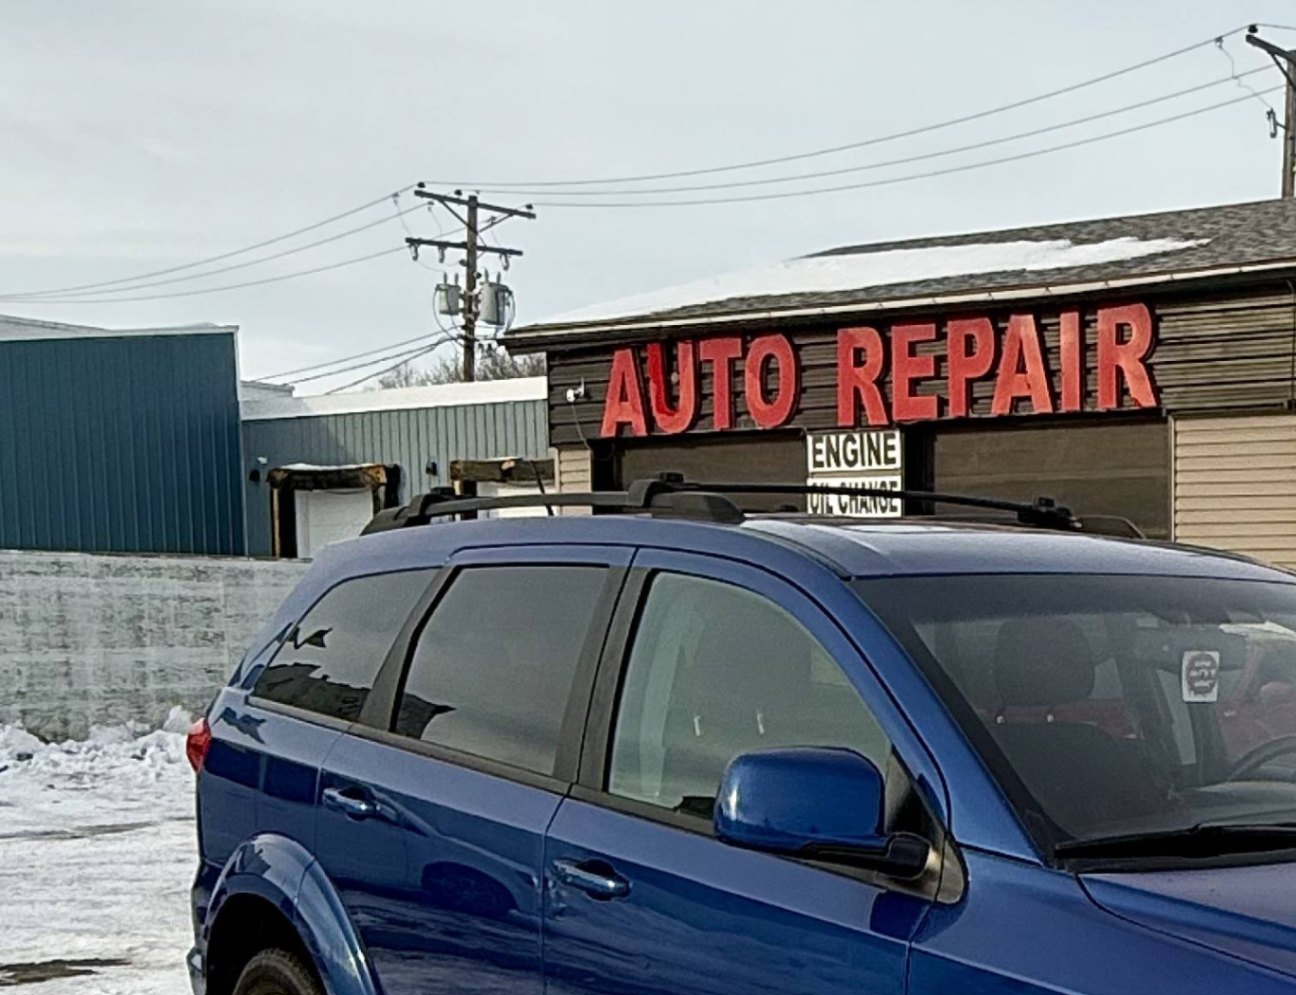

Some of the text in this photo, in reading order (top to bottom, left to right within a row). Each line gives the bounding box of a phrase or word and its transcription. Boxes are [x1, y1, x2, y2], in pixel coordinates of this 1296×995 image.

[601, 302, 1157, 438] AUTO REPAIR
[812, 432, 897, 468] ENGINE
